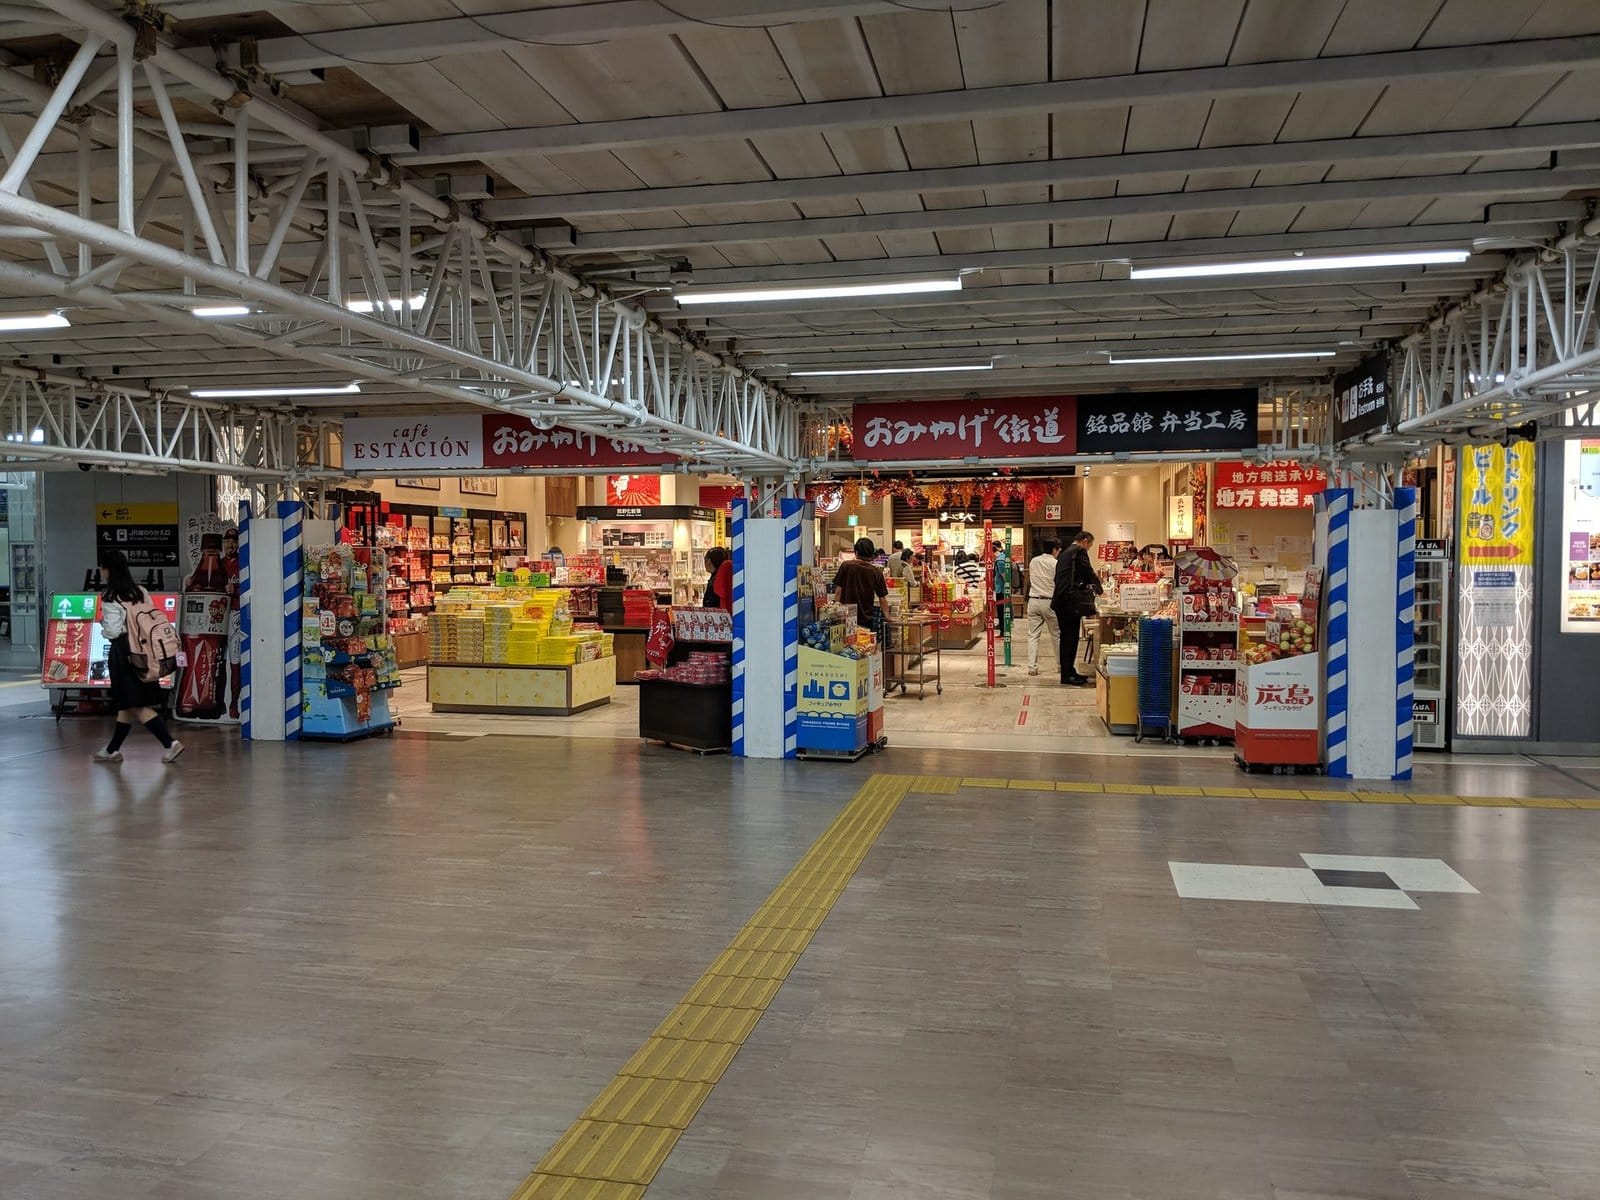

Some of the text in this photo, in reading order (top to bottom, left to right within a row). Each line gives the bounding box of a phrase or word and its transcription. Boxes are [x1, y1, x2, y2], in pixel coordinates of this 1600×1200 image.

[393, 423, 429, 442] café
[863, 406, 1067, 448] おみやげ街道
[1085, 408, 1249, 435] 銘品館 弁当工房
[354, 436, 470, 459] ESTACIÓN
[1472, 450, 1492, 505] ビール
[504, 575, 541, 584] 広島レモン
[54, 620, 68, 657] 販売中
[68, 621, 85, 682] サンドイッチ
[1254, 683, 1315, 706] 広島
